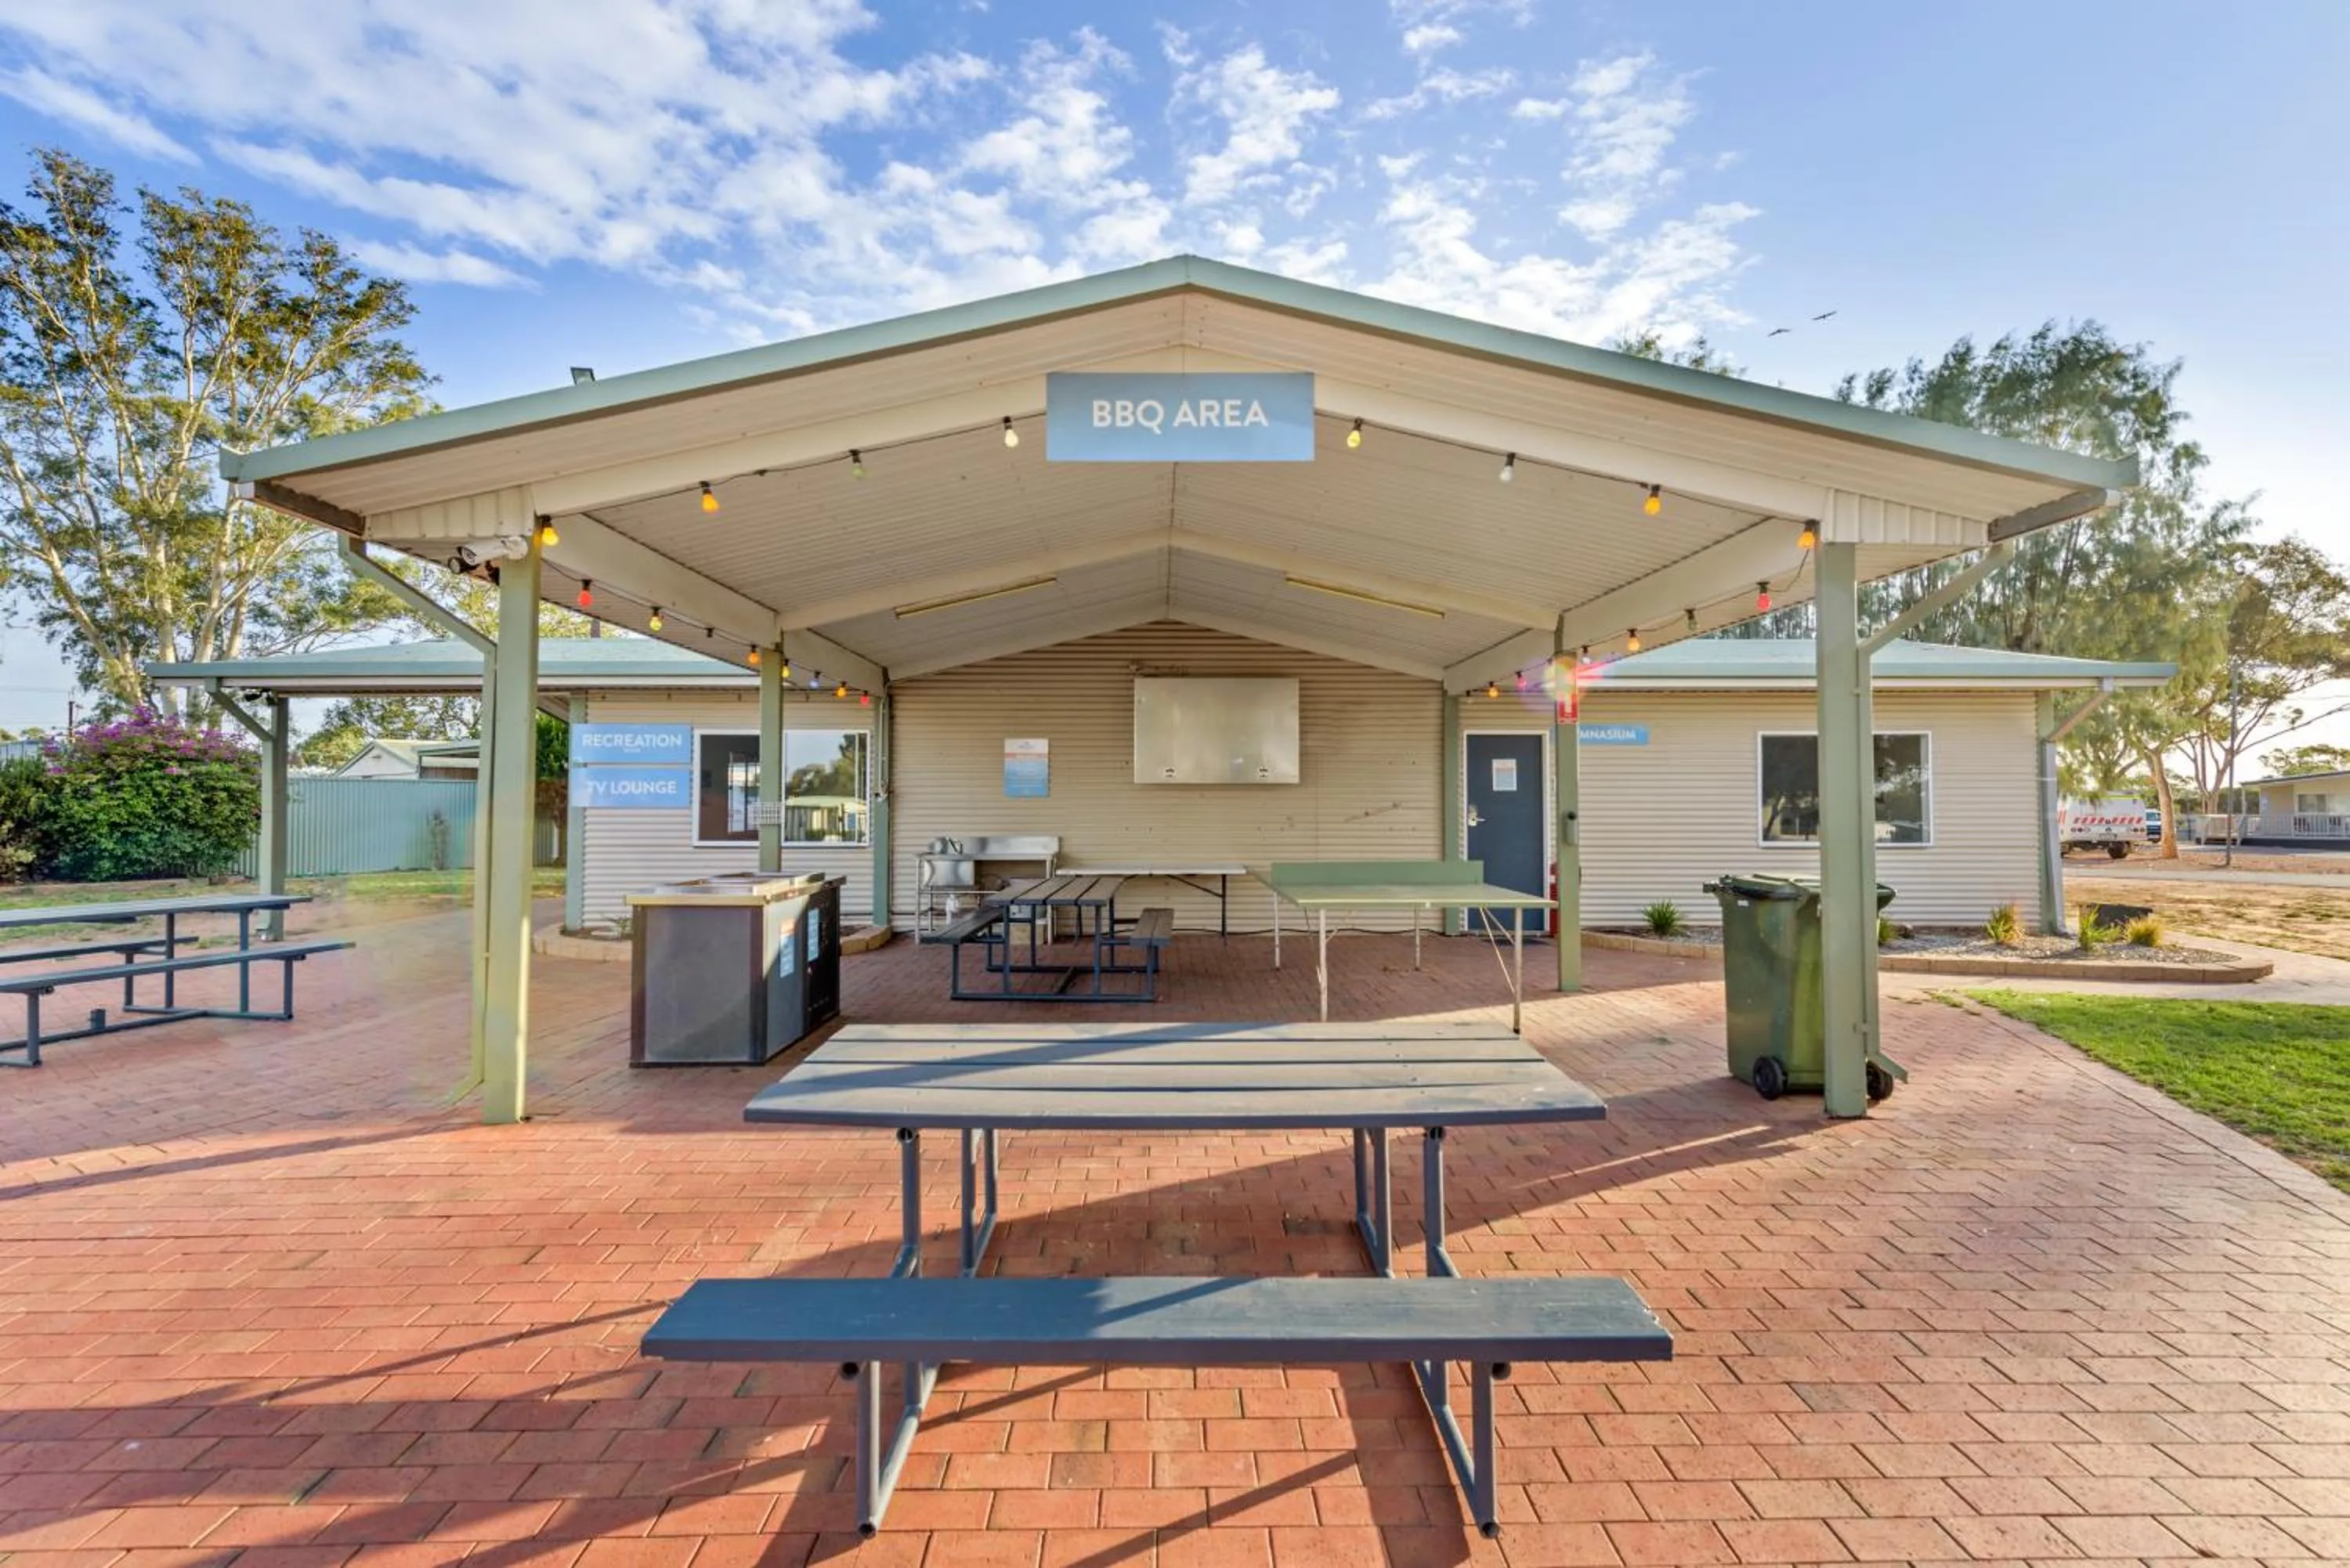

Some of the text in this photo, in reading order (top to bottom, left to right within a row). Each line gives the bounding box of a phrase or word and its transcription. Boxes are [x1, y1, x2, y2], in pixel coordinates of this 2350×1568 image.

[1093, 399, 1269, 435] BBQ AREA
[582, 733, 682, 747] RECREATION
[1579, 729, 1636, 739] MNASIUM
[587, 781, 677, 794] TV LOUNGE
